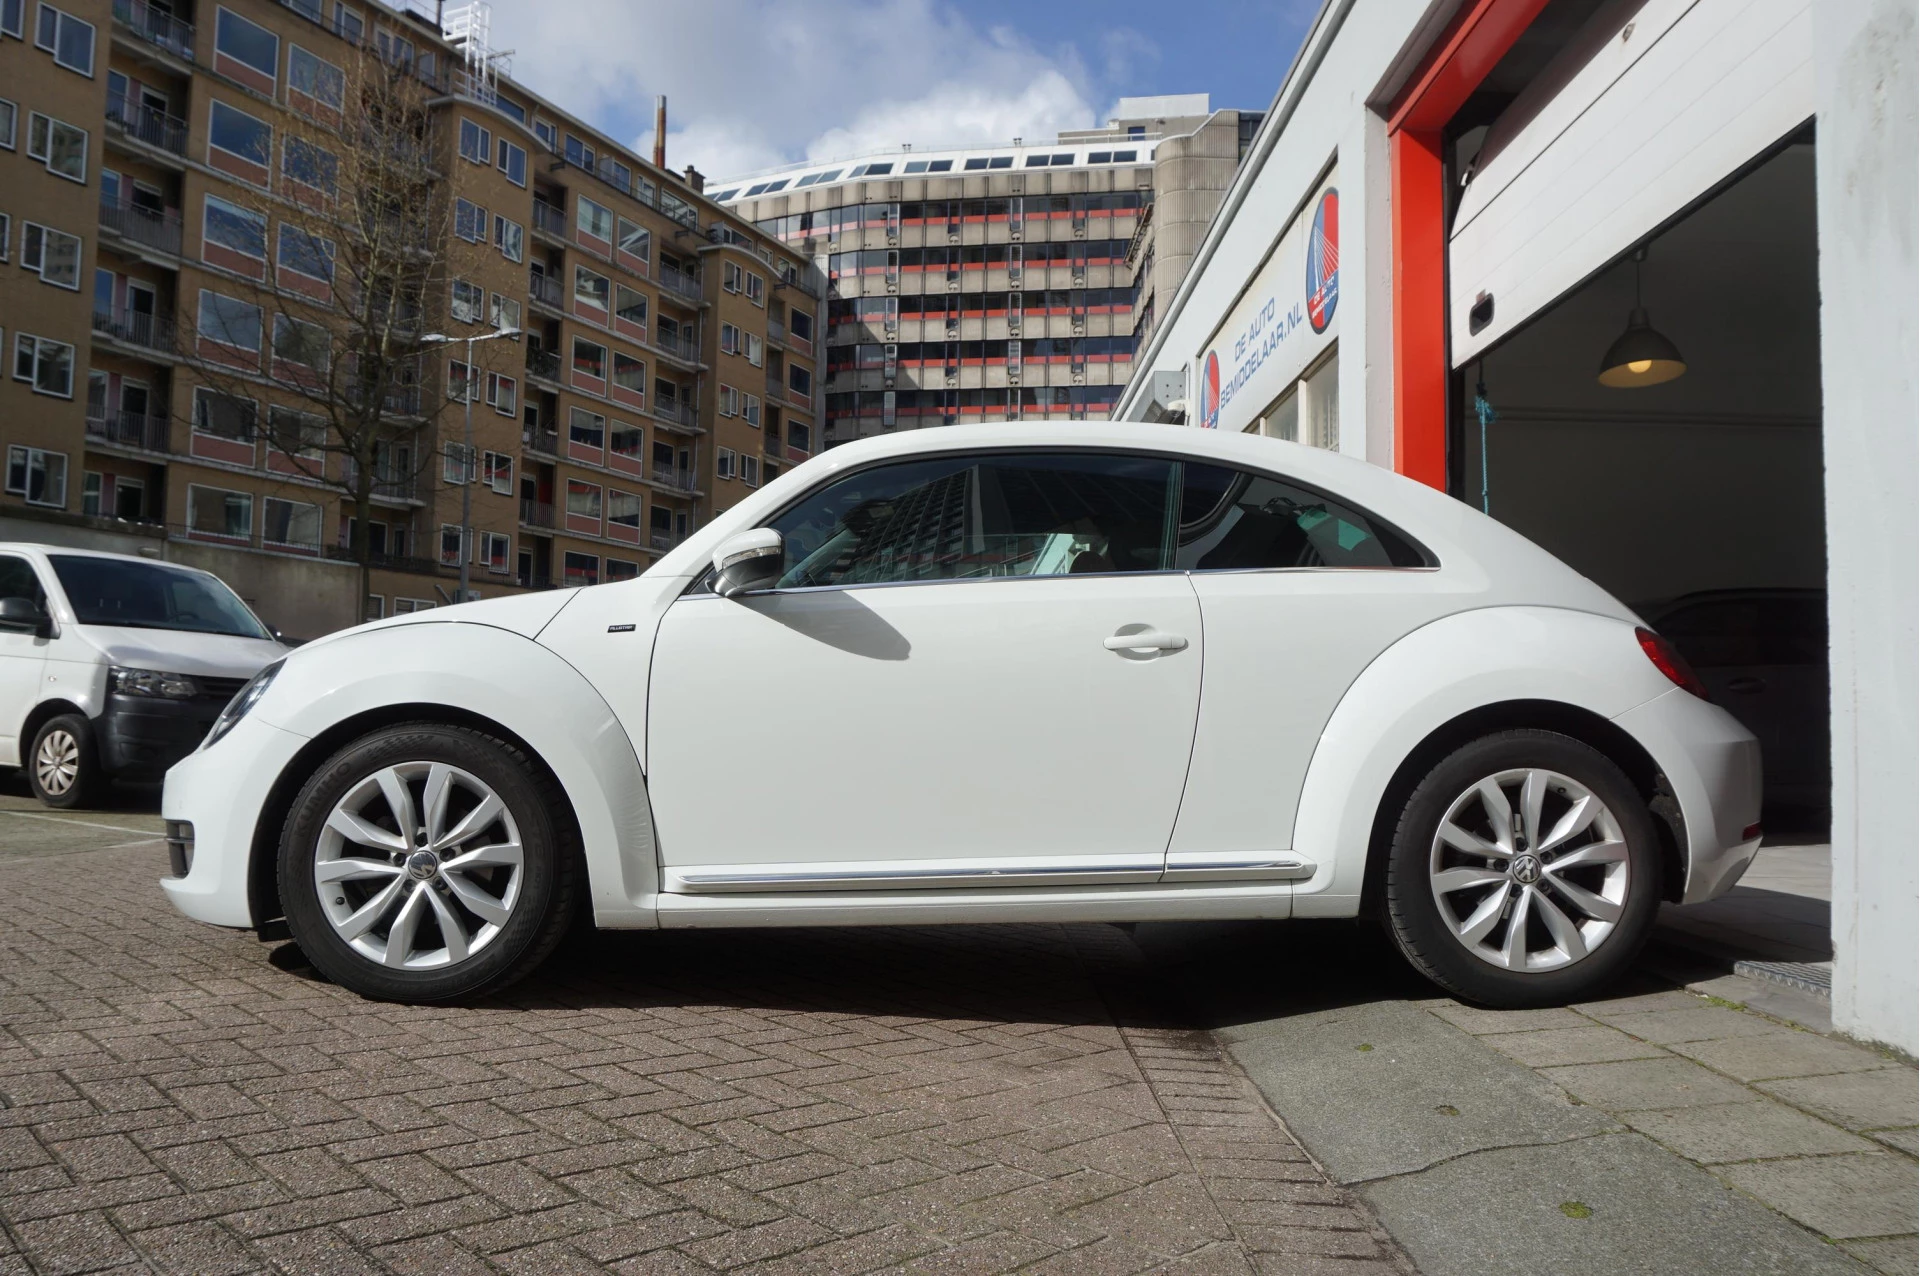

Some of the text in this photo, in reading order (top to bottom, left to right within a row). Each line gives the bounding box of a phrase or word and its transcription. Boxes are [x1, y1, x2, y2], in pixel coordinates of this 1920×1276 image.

[1220, 302, 1303, 410] BEMIDDELAAR.NL
[1234, 297, 1275, 362] DE AUTO
[295, 761, 351, 838] KUMHO
